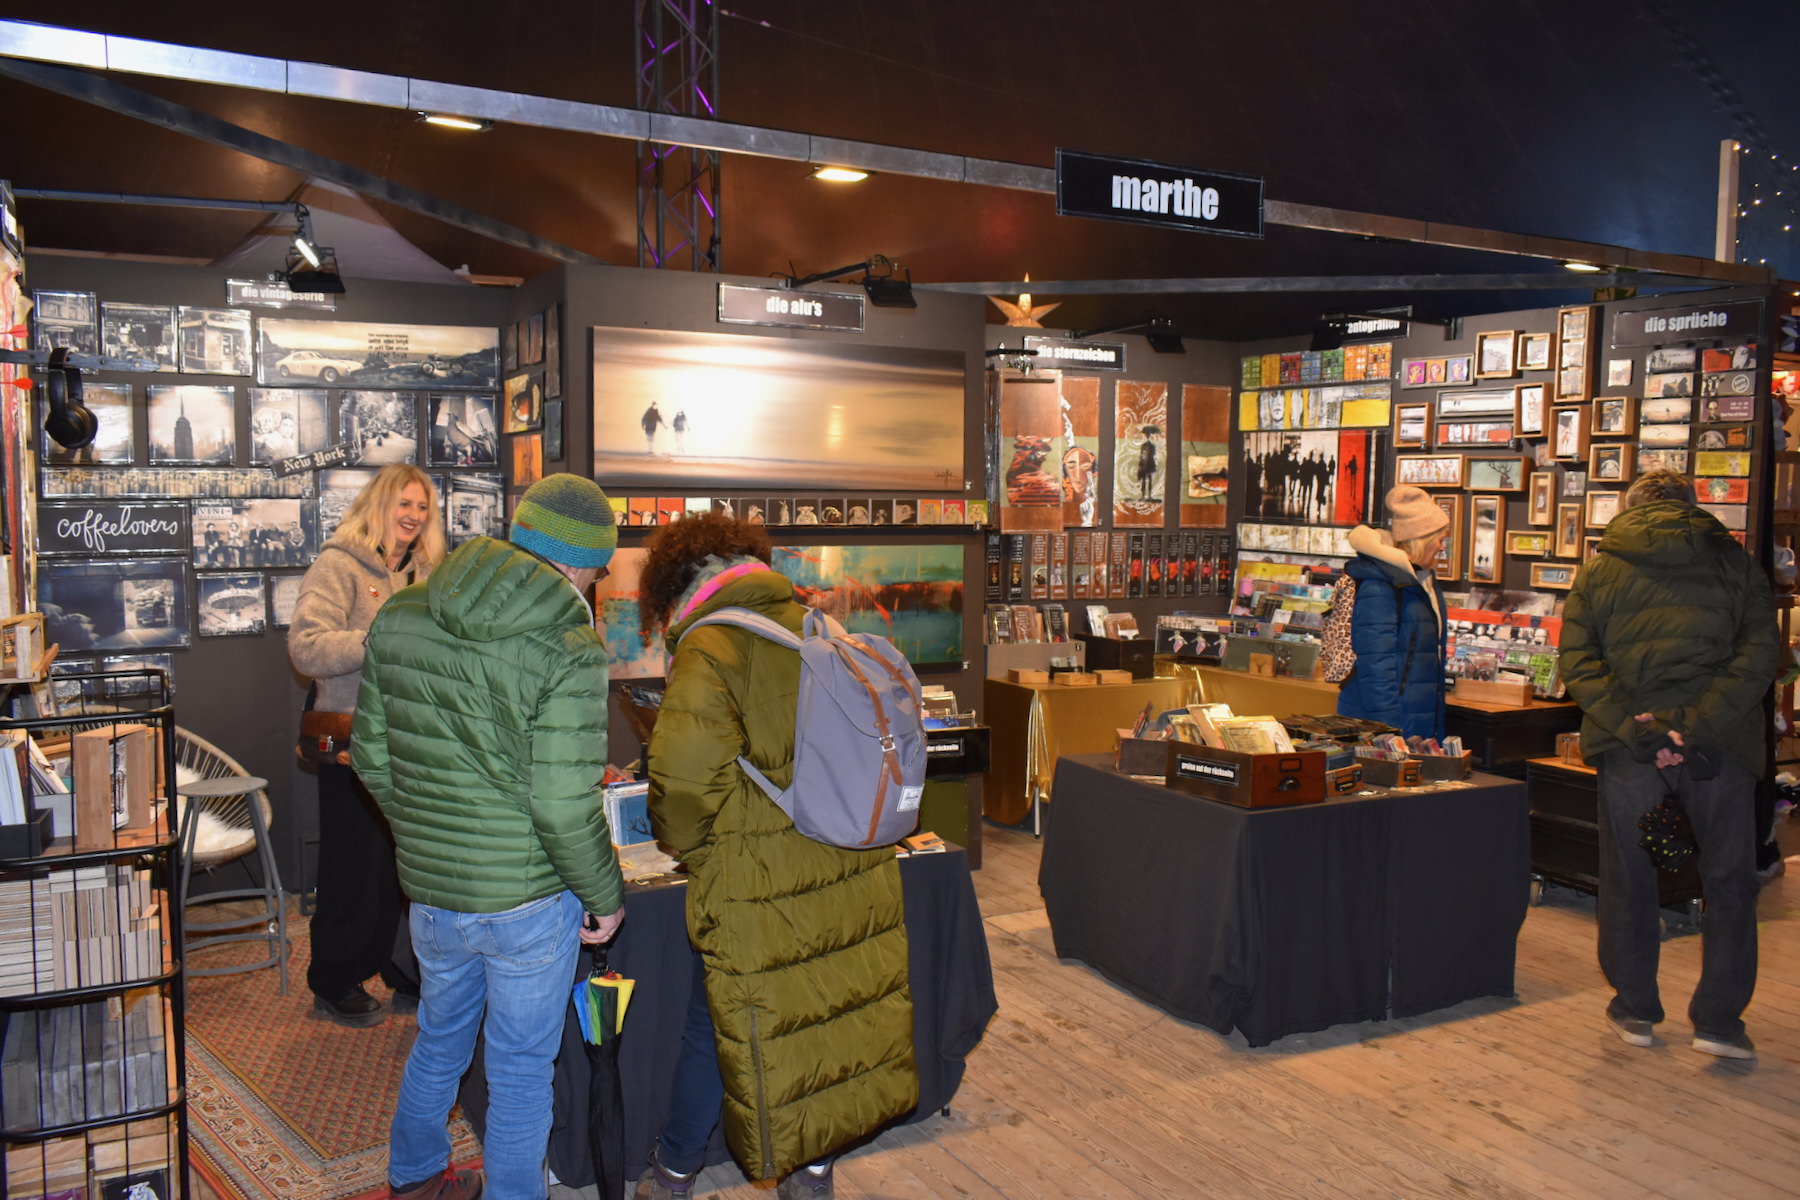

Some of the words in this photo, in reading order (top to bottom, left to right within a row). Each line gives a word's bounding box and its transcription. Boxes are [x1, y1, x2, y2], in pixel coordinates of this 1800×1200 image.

[1111, 175, 1219, 221] marthe
[241, 286, 258, 298] die
[766, 296, 789, 314] die
[1644, 316, 1666, 333] die
[1668, 311, 1727, 332] sprüche
[1037, 345, 1053, 358] die
[1054, 347, 1116, 362] sternzeichen
[283, 458, 311, 473] New
[313, 447, 346, 467] York
[57, 507, 178, 552] coffeelovers
